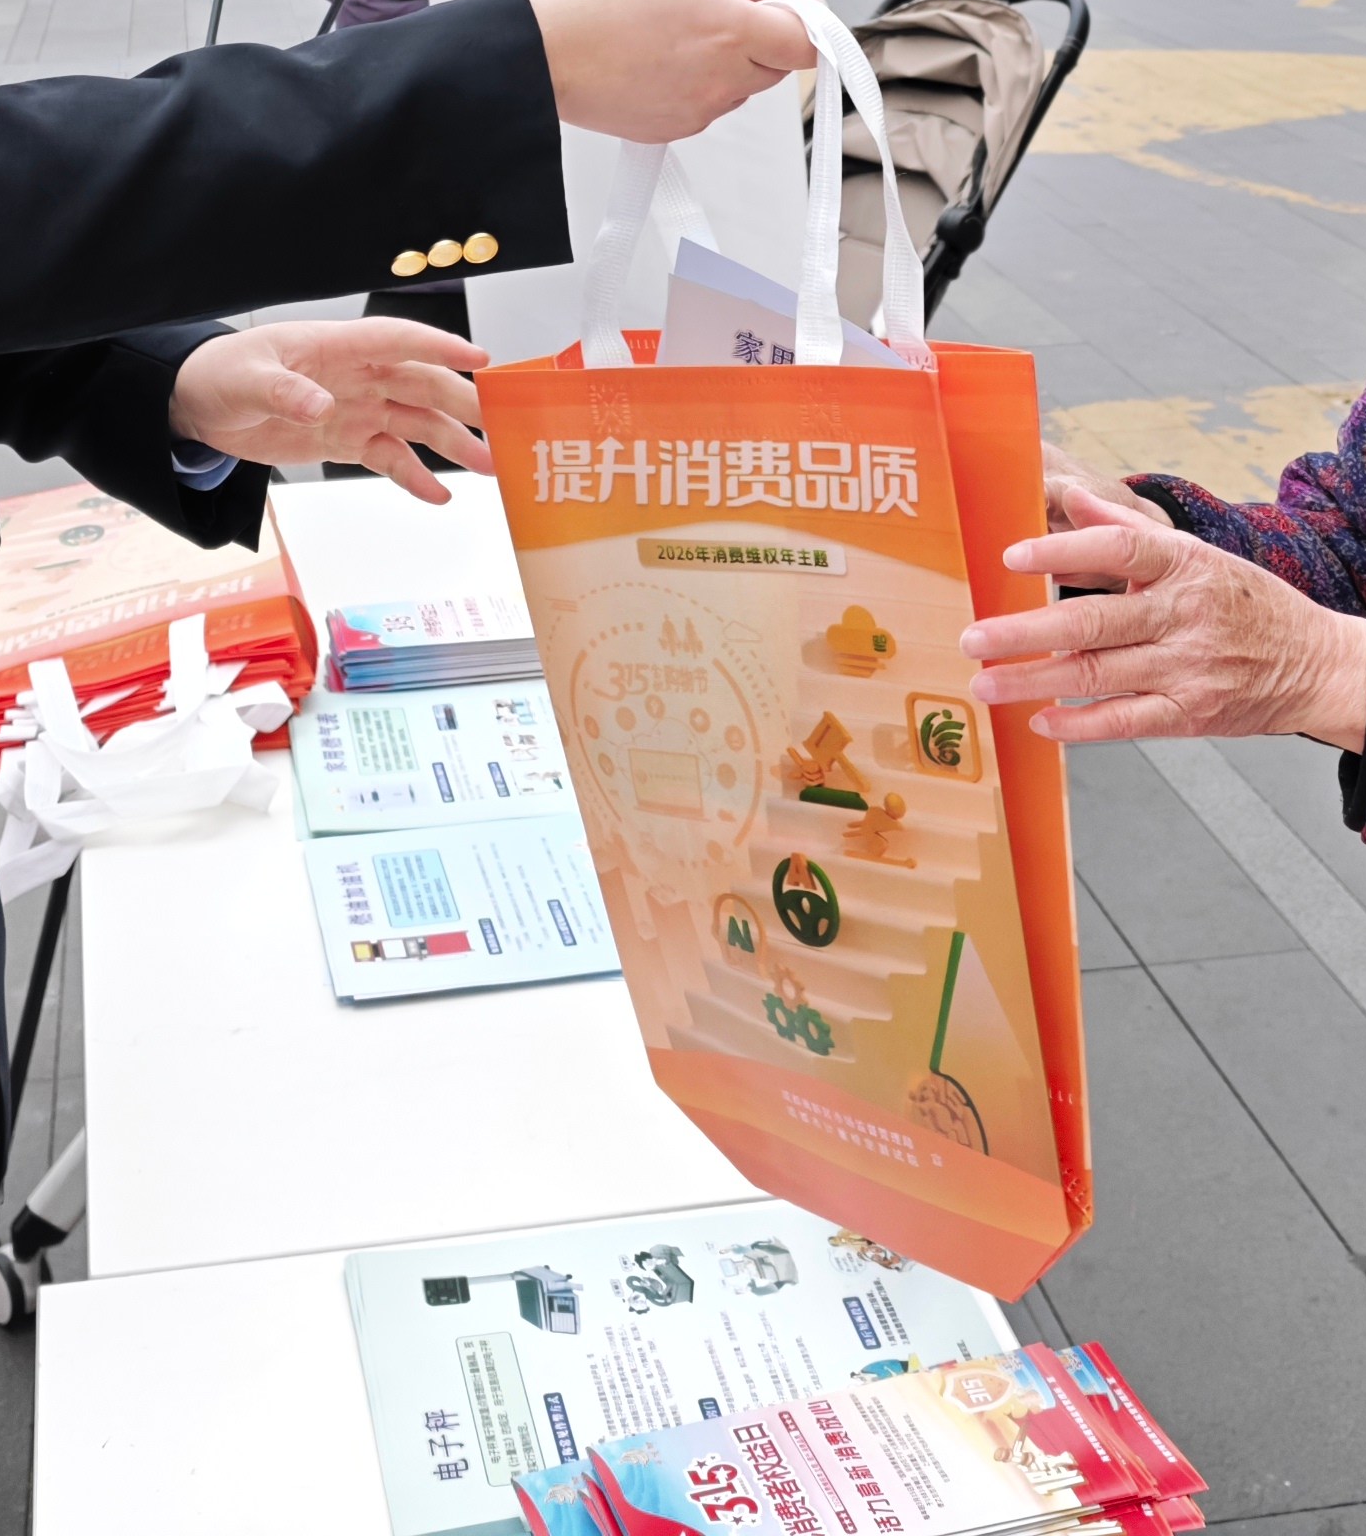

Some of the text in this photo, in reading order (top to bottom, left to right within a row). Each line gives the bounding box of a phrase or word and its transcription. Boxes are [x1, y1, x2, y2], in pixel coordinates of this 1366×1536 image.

[532, 437, 920, 518] 提升消费品质
[657, 543, 830, 569] 2026年消费维权年主题
[424, 1408, 470, 1482] 电子秤
[805, 1399, 861, 1462] 消费放心
[690, 1460, 761, 1526] 315
[736, 1422, 825, 1536] 消费者权益日
[845, 1464, 903, 1534] 活力高新
